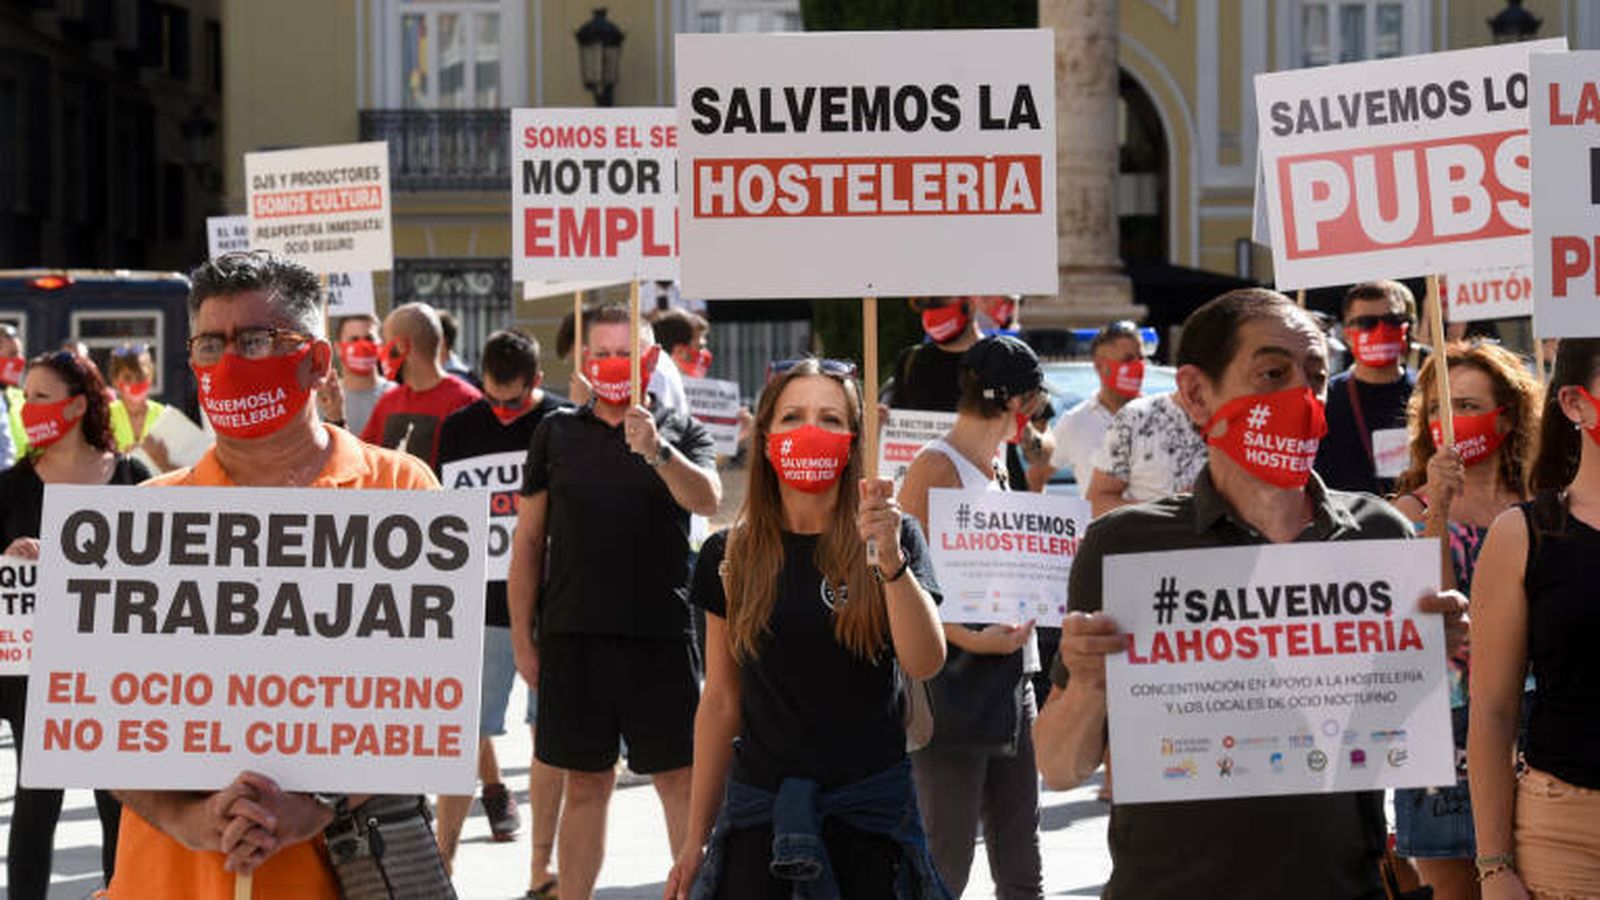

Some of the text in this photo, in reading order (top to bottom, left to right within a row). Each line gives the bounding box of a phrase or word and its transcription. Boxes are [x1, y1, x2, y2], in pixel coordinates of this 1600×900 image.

[690, 83, 1042, 135] SALVEMOS LA
[1270, 72, 1528, 137] SALVEMOS LO
[1548, 82, 1600, 126] LA
[523, 125, 607, 149] SOMOS
[615, 126, 643, 148] EL
[290, 166, 381, 186] PRODUCTORES
[522, 159, 661, 195] MOTOR
[699, 156, 1038, 215] HOSTELERÍA
[310, 187, 382, 212] CULTURA
[523, 207, 679, 258] EMPL
[1551, 235, 1600, 297] P
[1247, 404, 1271, 430] #
[60, 509, 470, 572] QUEREMOS
[956, 503, 1076, 537] #SALVEMOS
[67, 578, 455, 639] TRABAJAR
[1153, 577, 1393, 624] #SALVEMOS
[1127, 609, 1424, 665] LAHOSTELERÍA
[47, 672, 464, 711] EL OCIO NOCTURNO
[1166, 690, 1397, 714] Y LOS LOCALES DE OCIO NOCTURNO
[1249, 678, 1266, 691] EN
[1270, 677, 1312, 689] APOYO
[1314, 675, 1323, 687] A
[1326, 674, 1342, 687] LA
[43, 718, 463, 757] NO ES EL CULPABLE
